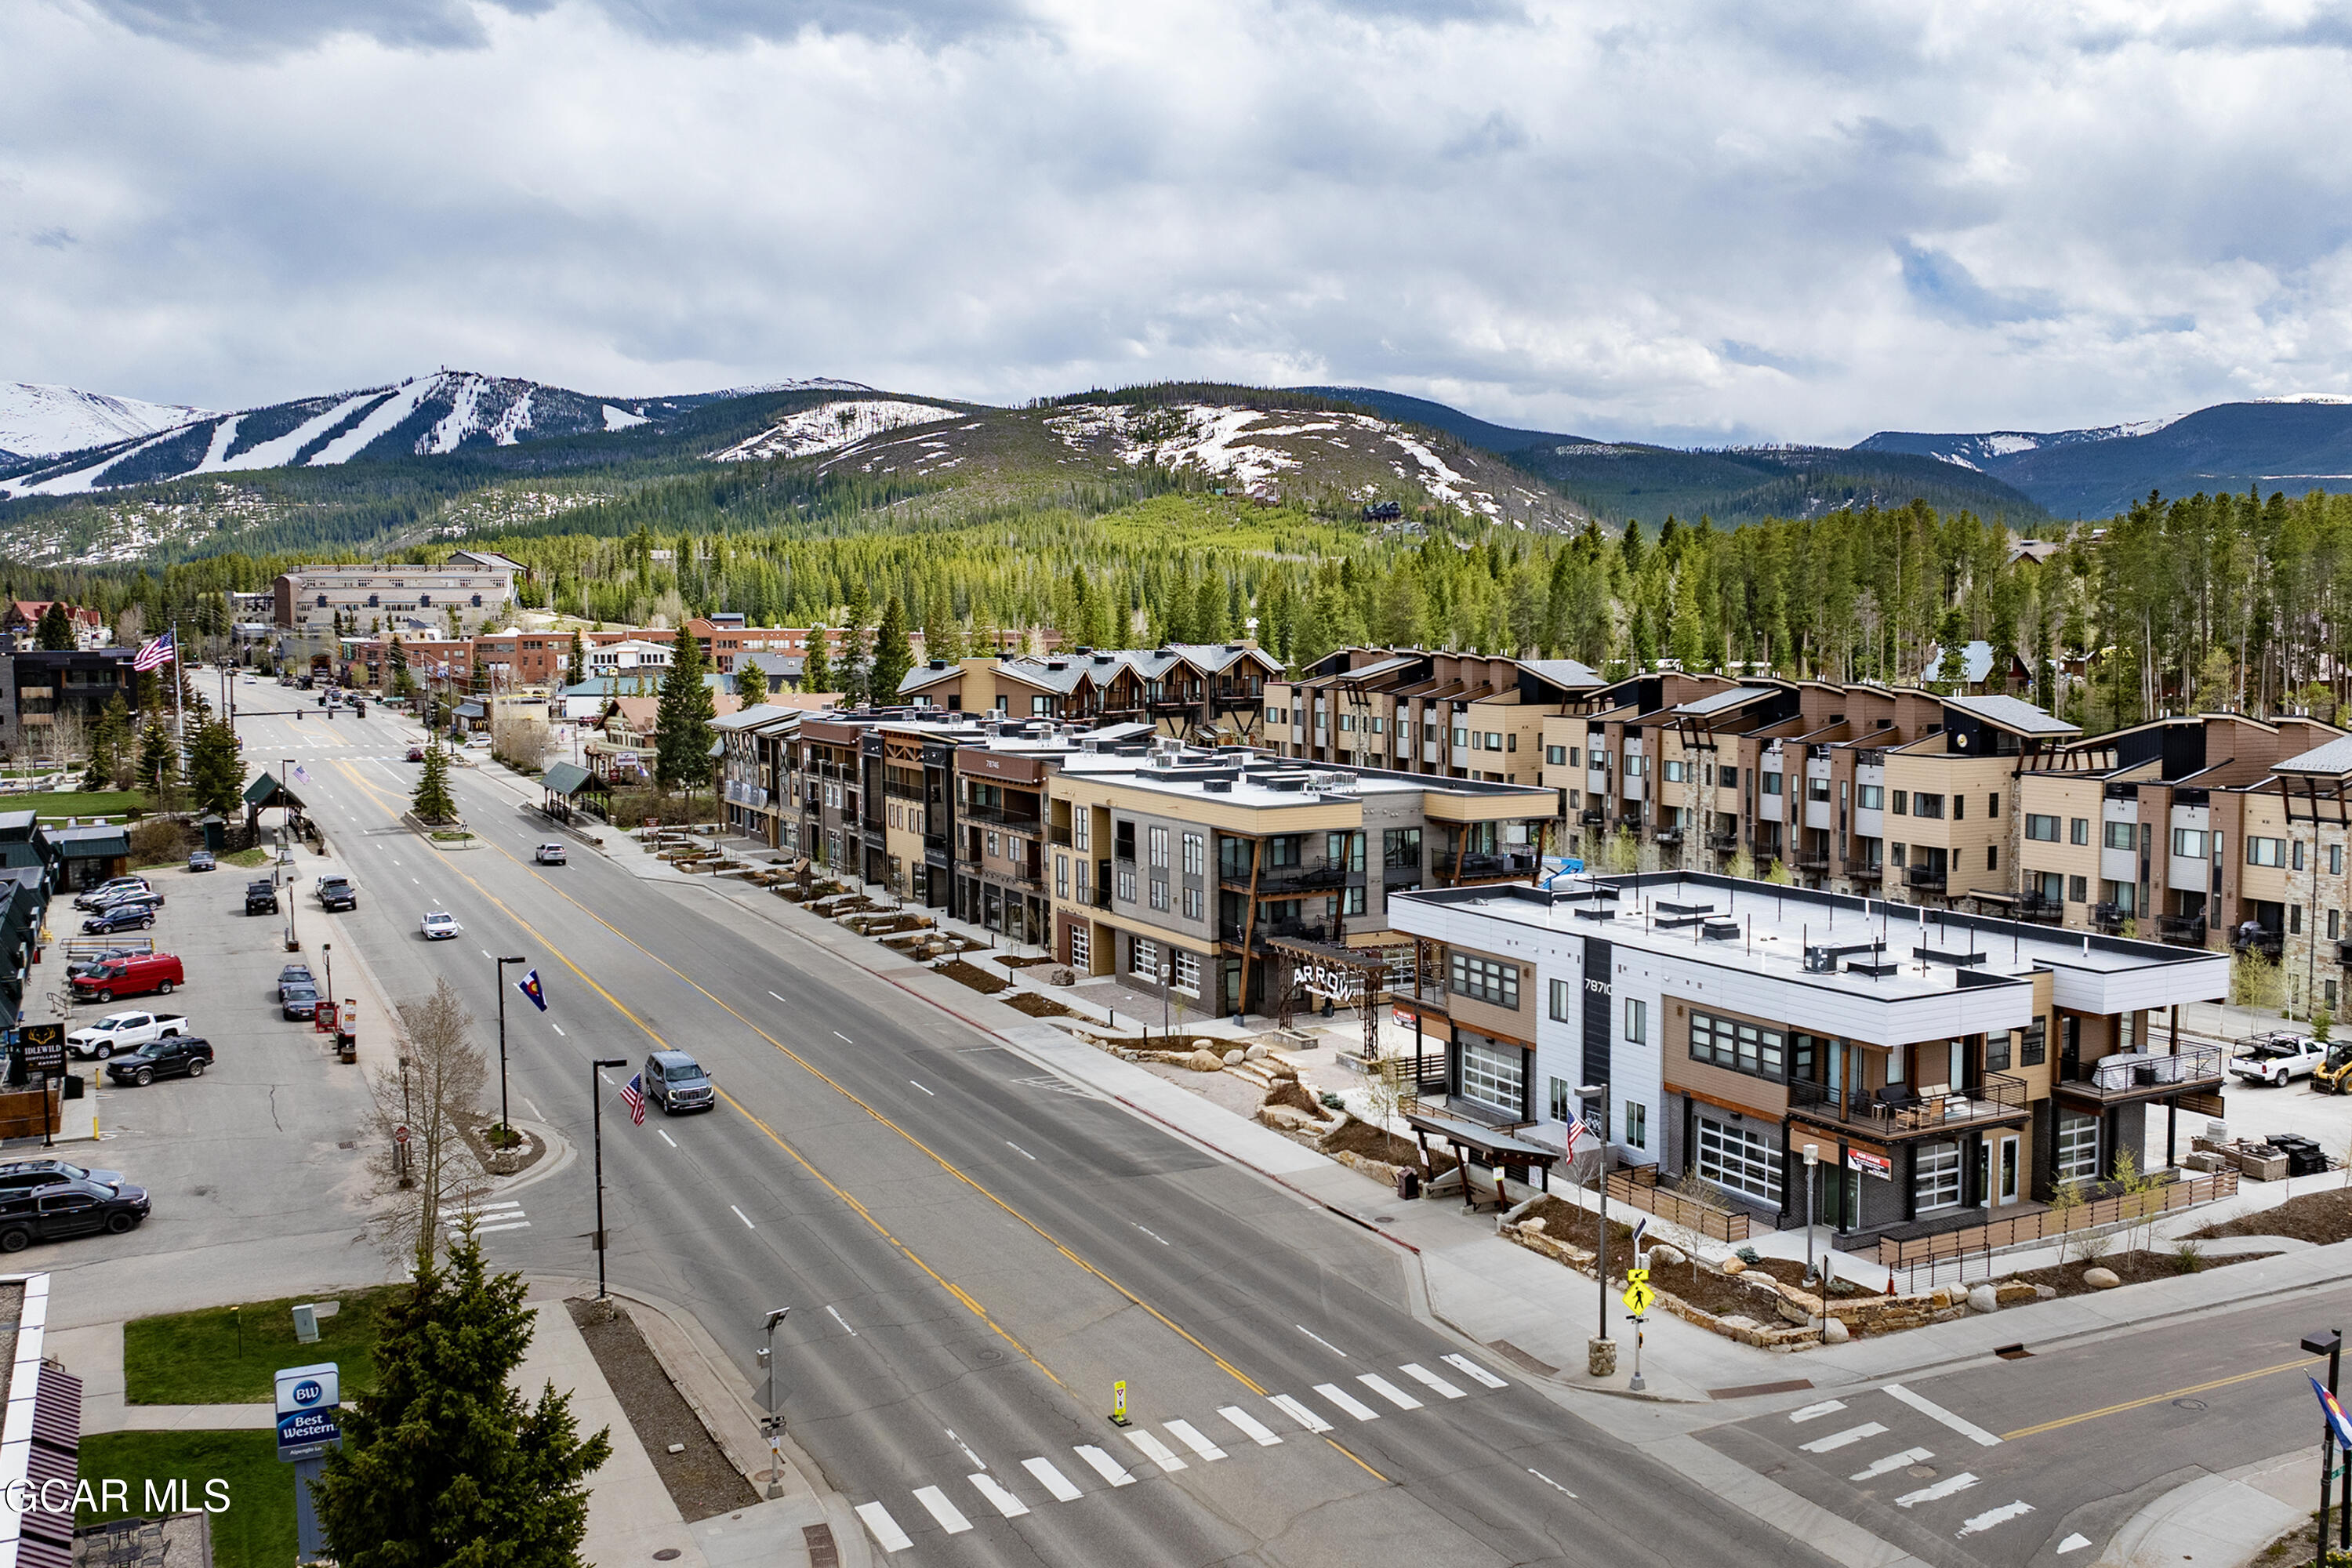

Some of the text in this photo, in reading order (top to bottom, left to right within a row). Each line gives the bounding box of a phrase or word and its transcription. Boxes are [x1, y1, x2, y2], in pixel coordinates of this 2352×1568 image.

[1294, 965, 1354, 1002] ARROW
[1585, 978, 1612, 996] 78710
[24, 1045, 62, 1055] IDLEWILD
[296, 1387, 319, 1400] BW
[296, 1414, 323, 1427] Best
[284, 1424, 335, 1439] Western
